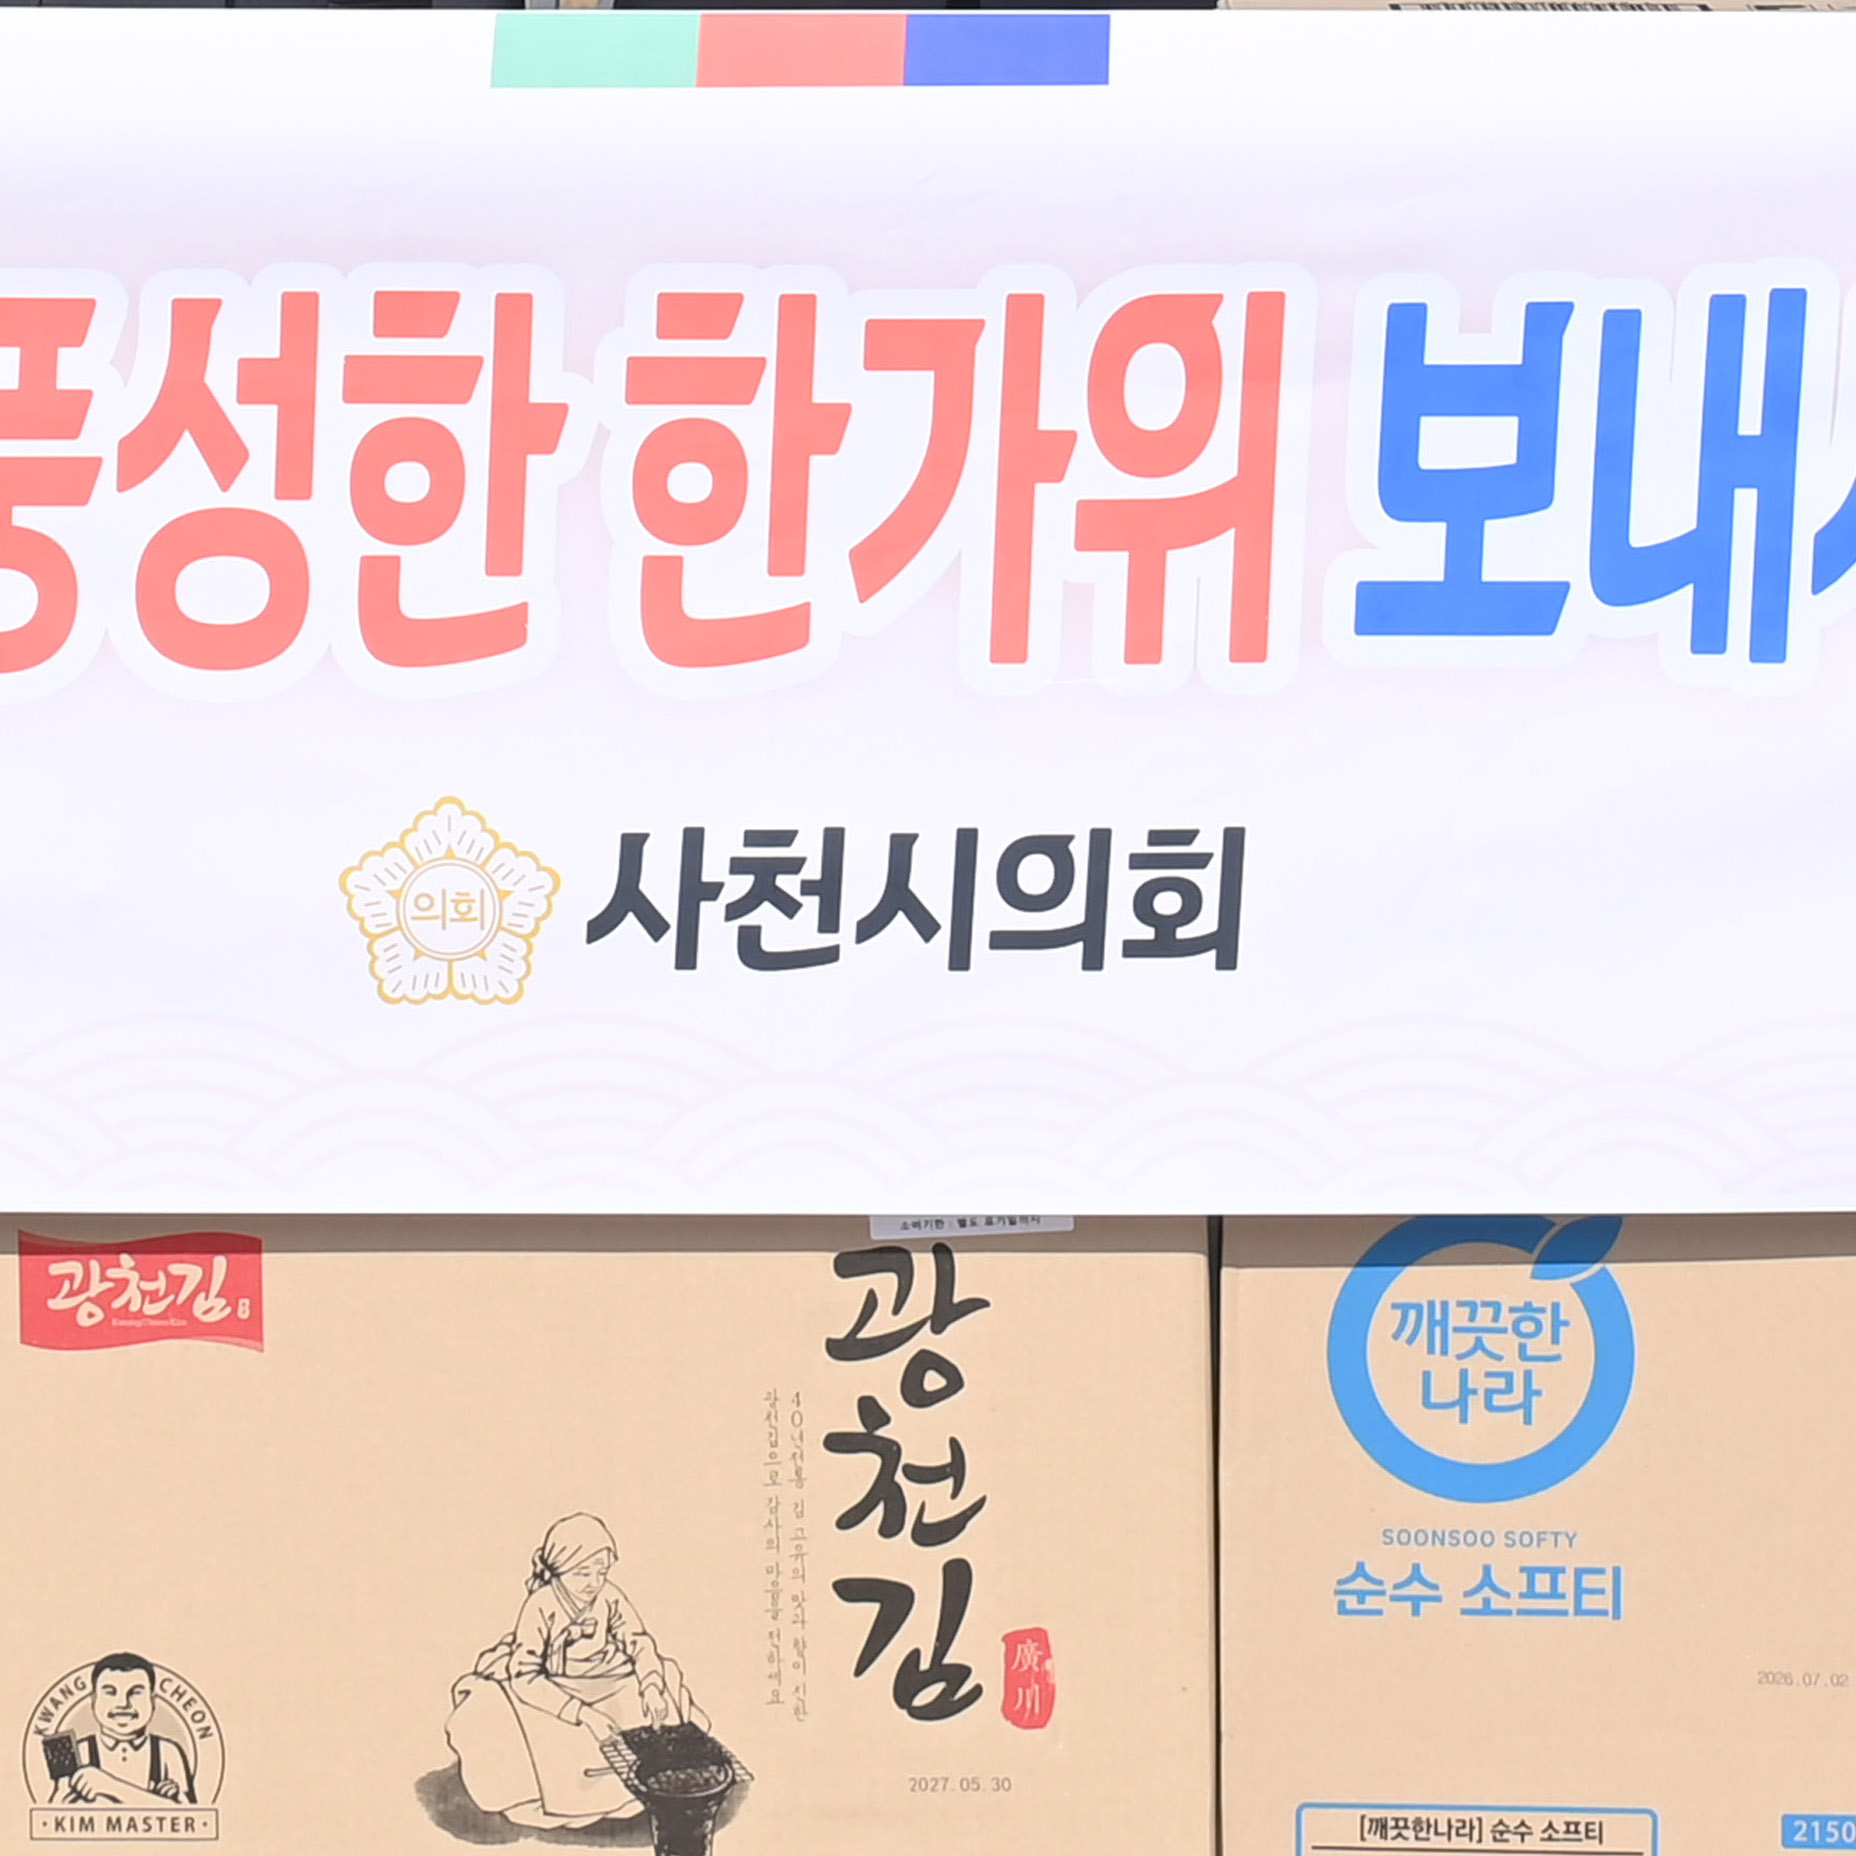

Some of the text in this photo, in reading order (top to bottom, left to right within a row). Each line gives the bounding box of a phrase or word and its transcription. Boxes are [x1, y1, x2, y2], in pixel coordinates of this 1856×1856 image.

[625, 290, 1286, 670] 한가위
[410, 888, 484, 931] 의회
[586, 826, 1246, 972] 사천시의회
[47, 1253, 232, 1327] 광천김
[1390, 1299, 1571, 1363] 깨끗한
[1421, 1367, 1544, 1426] 나라
[823, 1242, 991, 1721] 광천김
[1381, 1528, 1579, 1549] SOONSOO SOFTY
[1333, 1560, 1623, 1621] 순수 소프티
[33, 1675, 215, 1740] KWANG CHEON
[54, 1815, 197, 1833] KIM MASTER
[1359, 1814, 1604, 1845] [깨끗한나라] 순수 소프티
